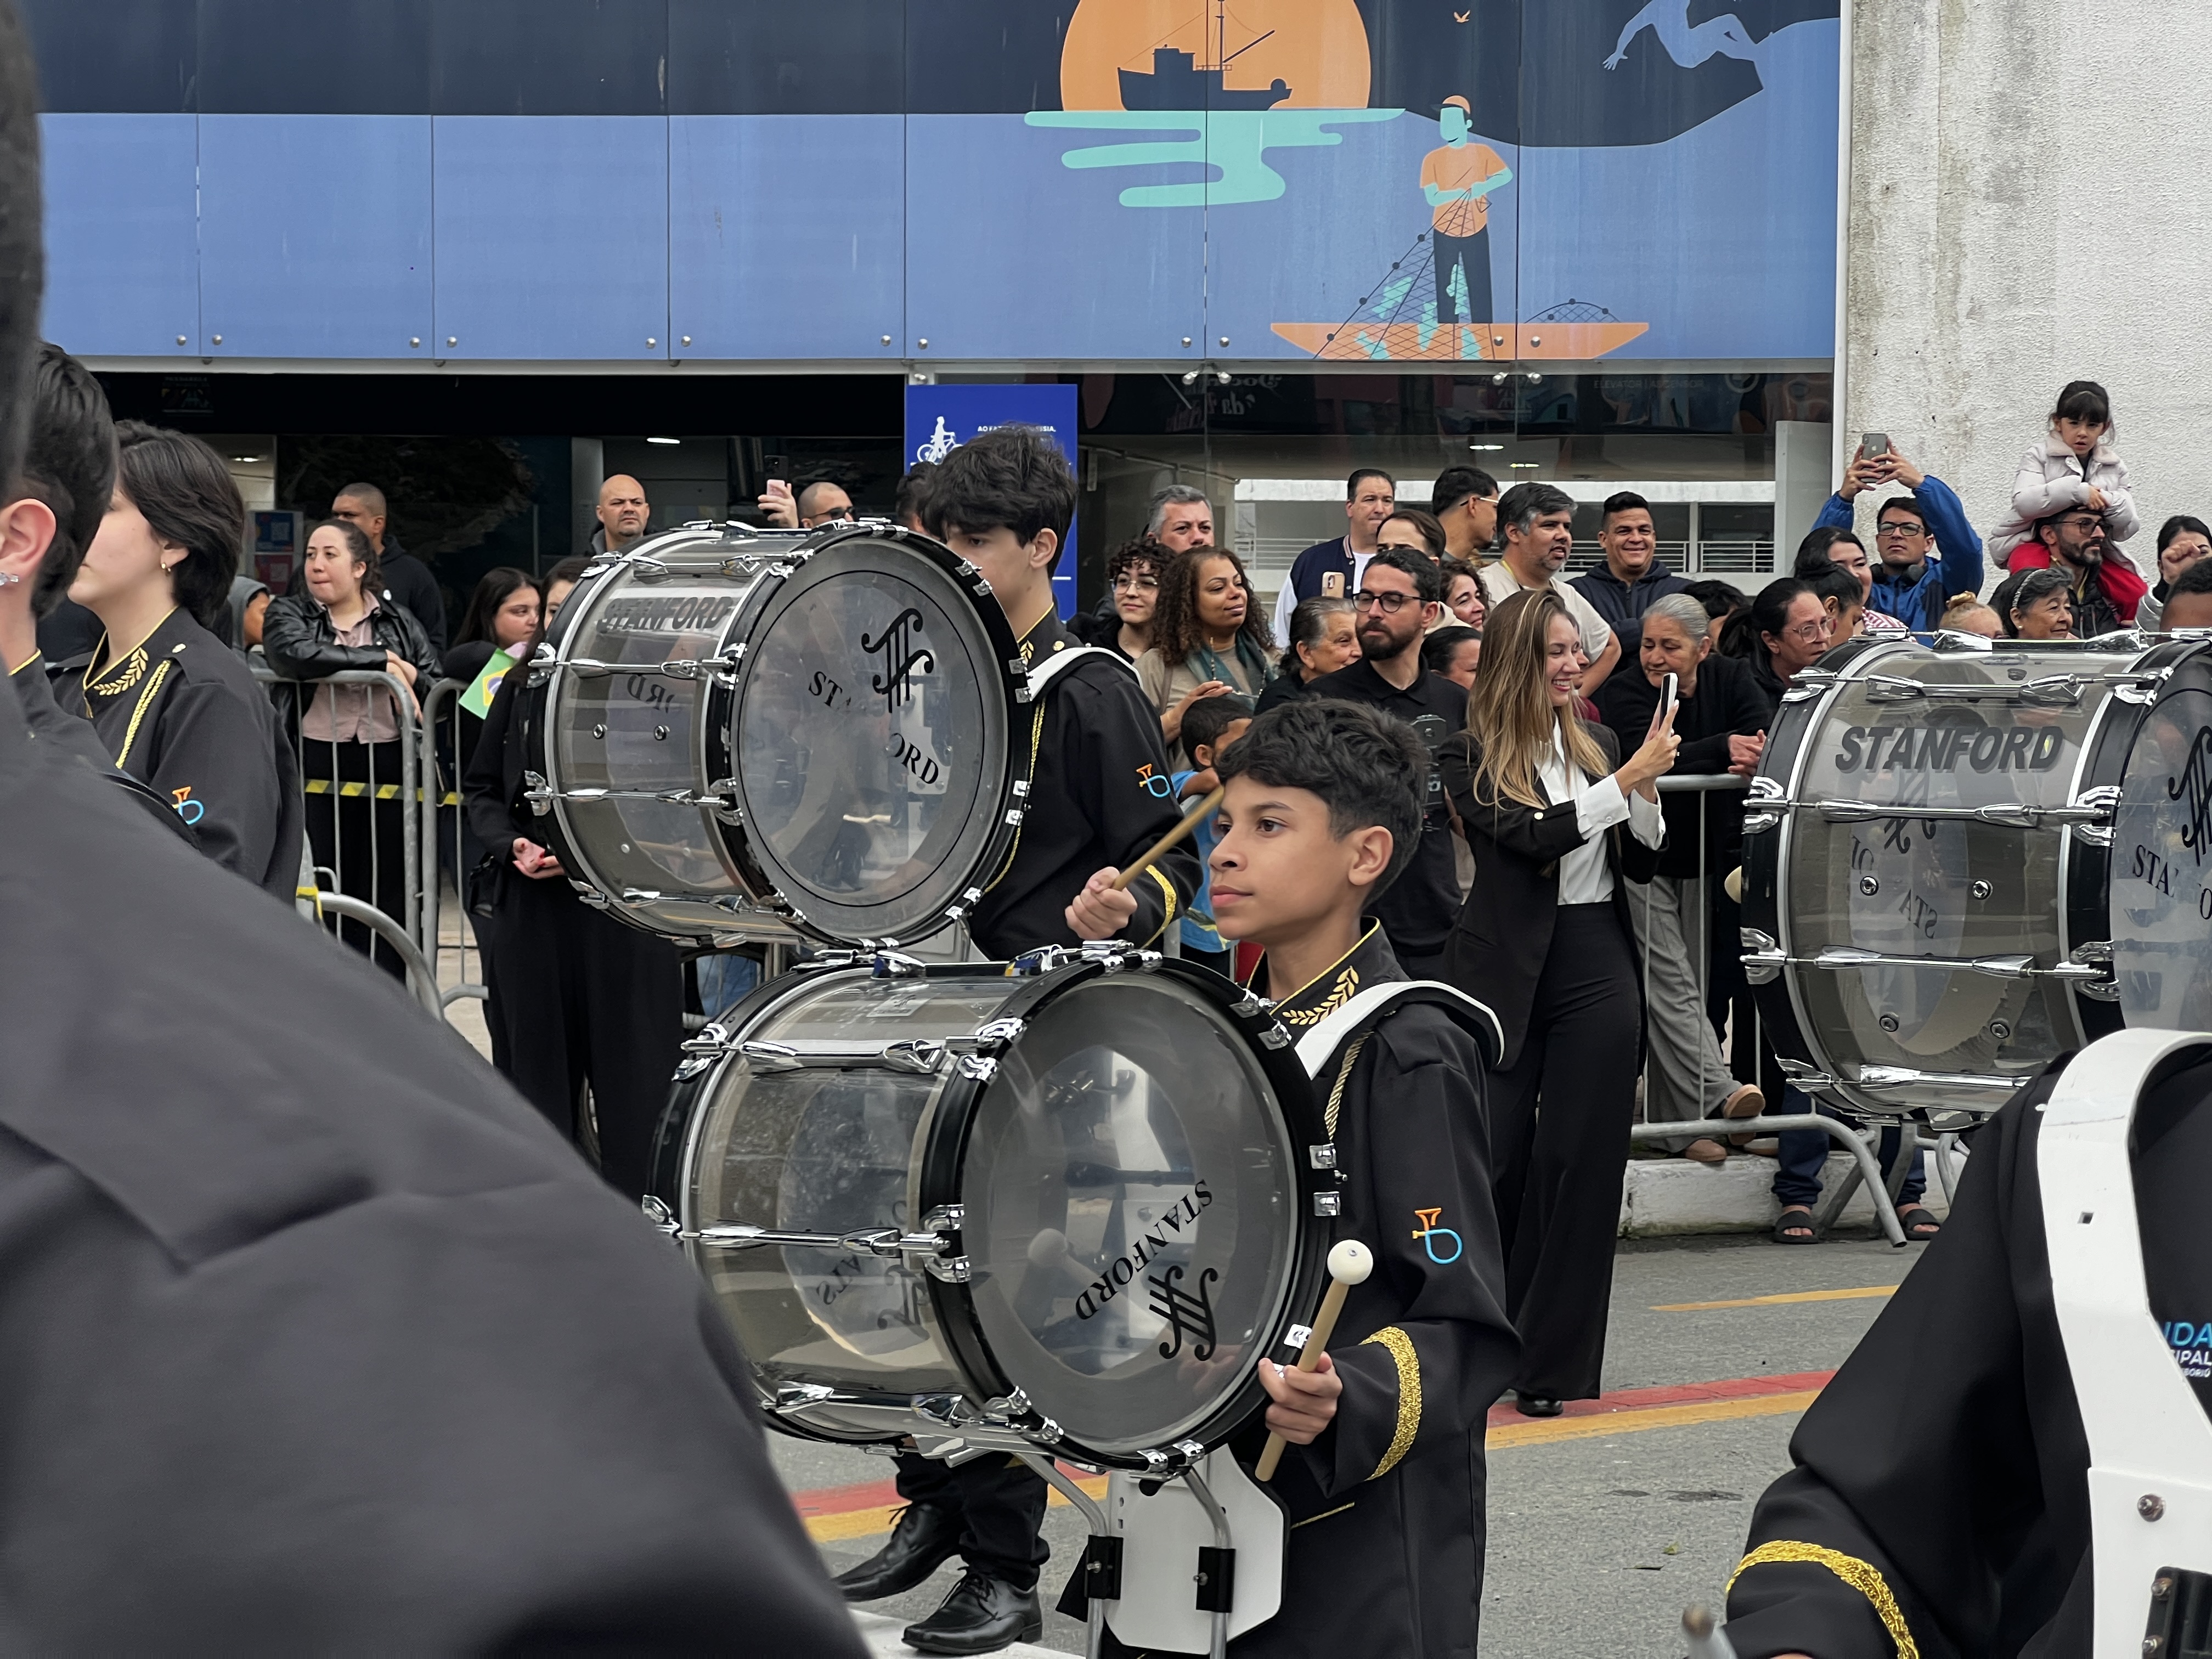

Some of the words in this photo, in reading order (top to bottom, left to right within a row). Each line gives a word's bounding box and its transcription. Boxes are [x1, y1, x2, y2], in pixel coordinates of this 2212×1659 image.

[596, 596, 735, 633] STANFORD
[1835, 726, 2064, 774] STANFORD
[1075, 1179, 1213, 1320] STANFORD
